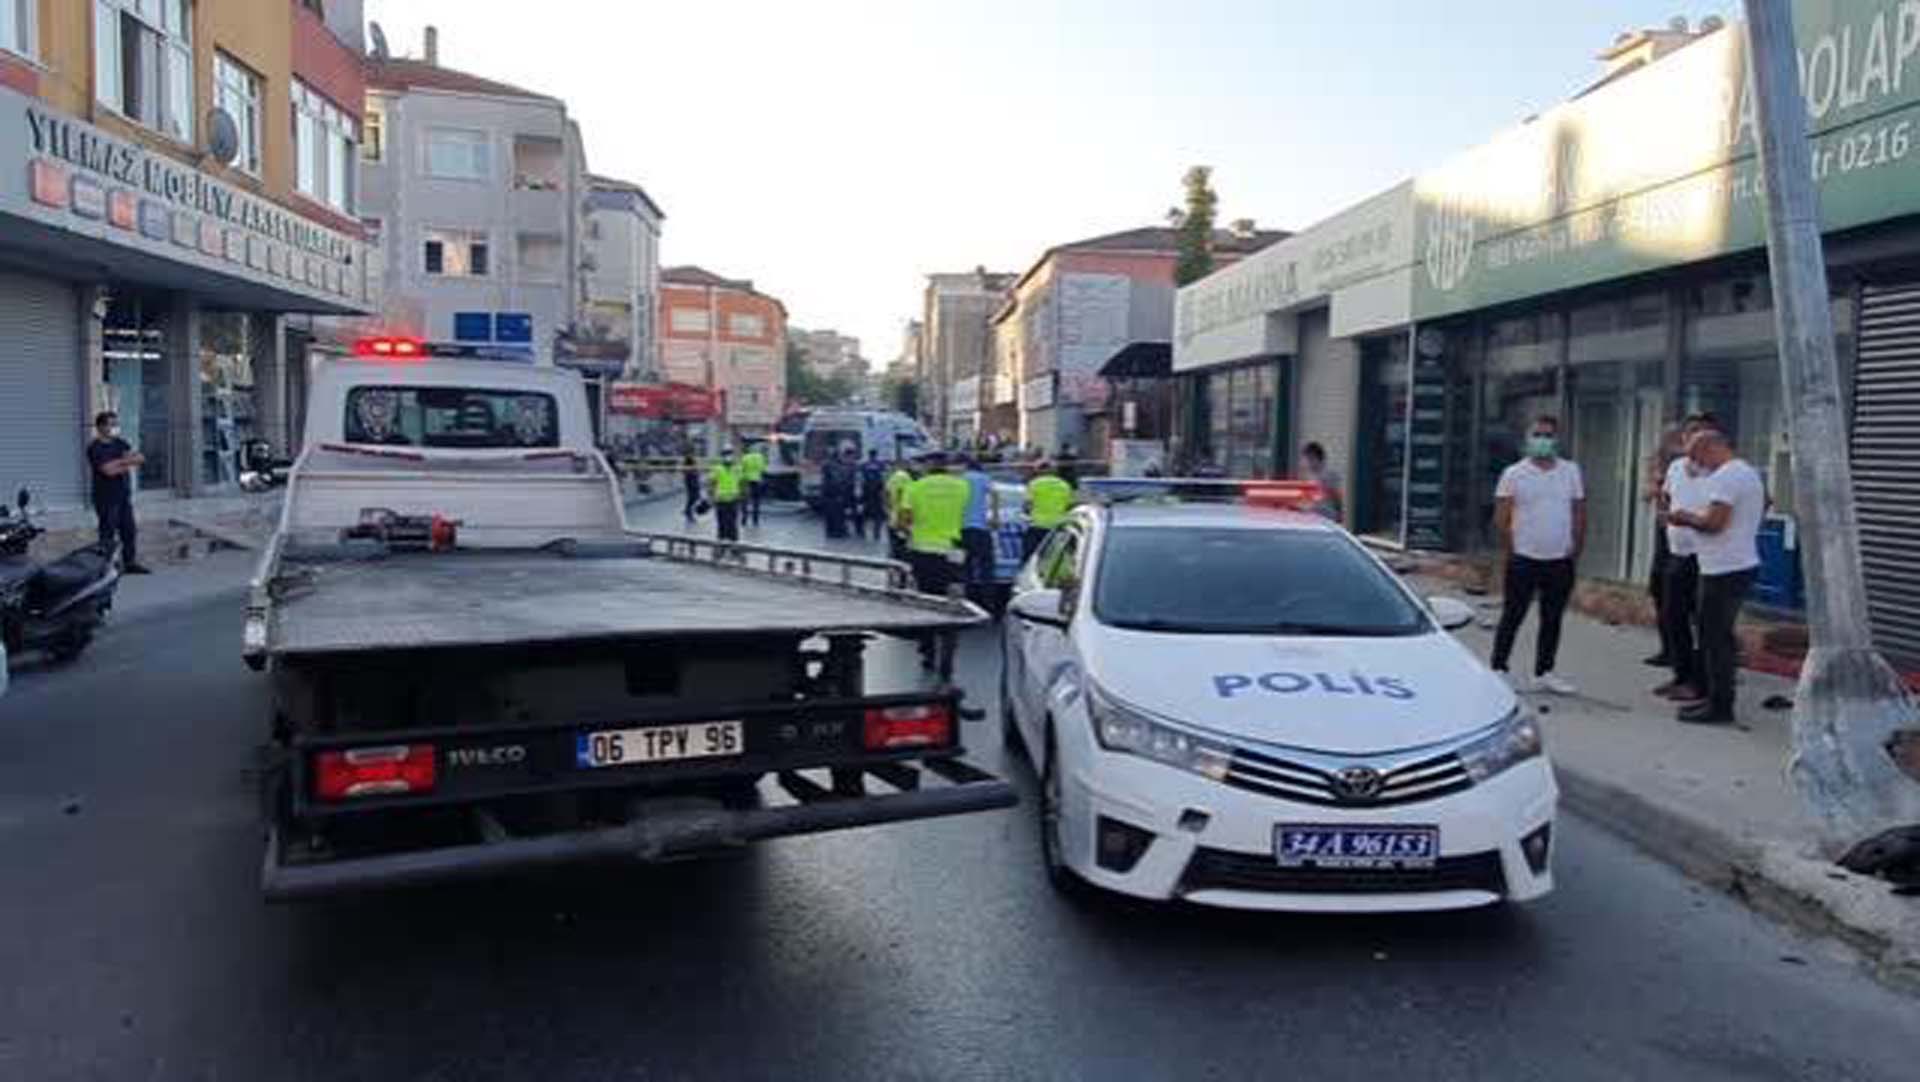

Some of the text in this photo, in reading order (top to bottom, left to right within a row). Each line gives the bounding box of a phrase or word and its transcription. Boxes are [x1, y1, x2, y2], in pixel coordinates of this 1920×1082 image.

[26, 107, 139, 186] YILMAZ
[1840, 121, 1910, 173] 0216
[449, 745, 526, 766] IVECO
[593, 735, 624, 764] 06
[704, 725, 738, 752] 96
